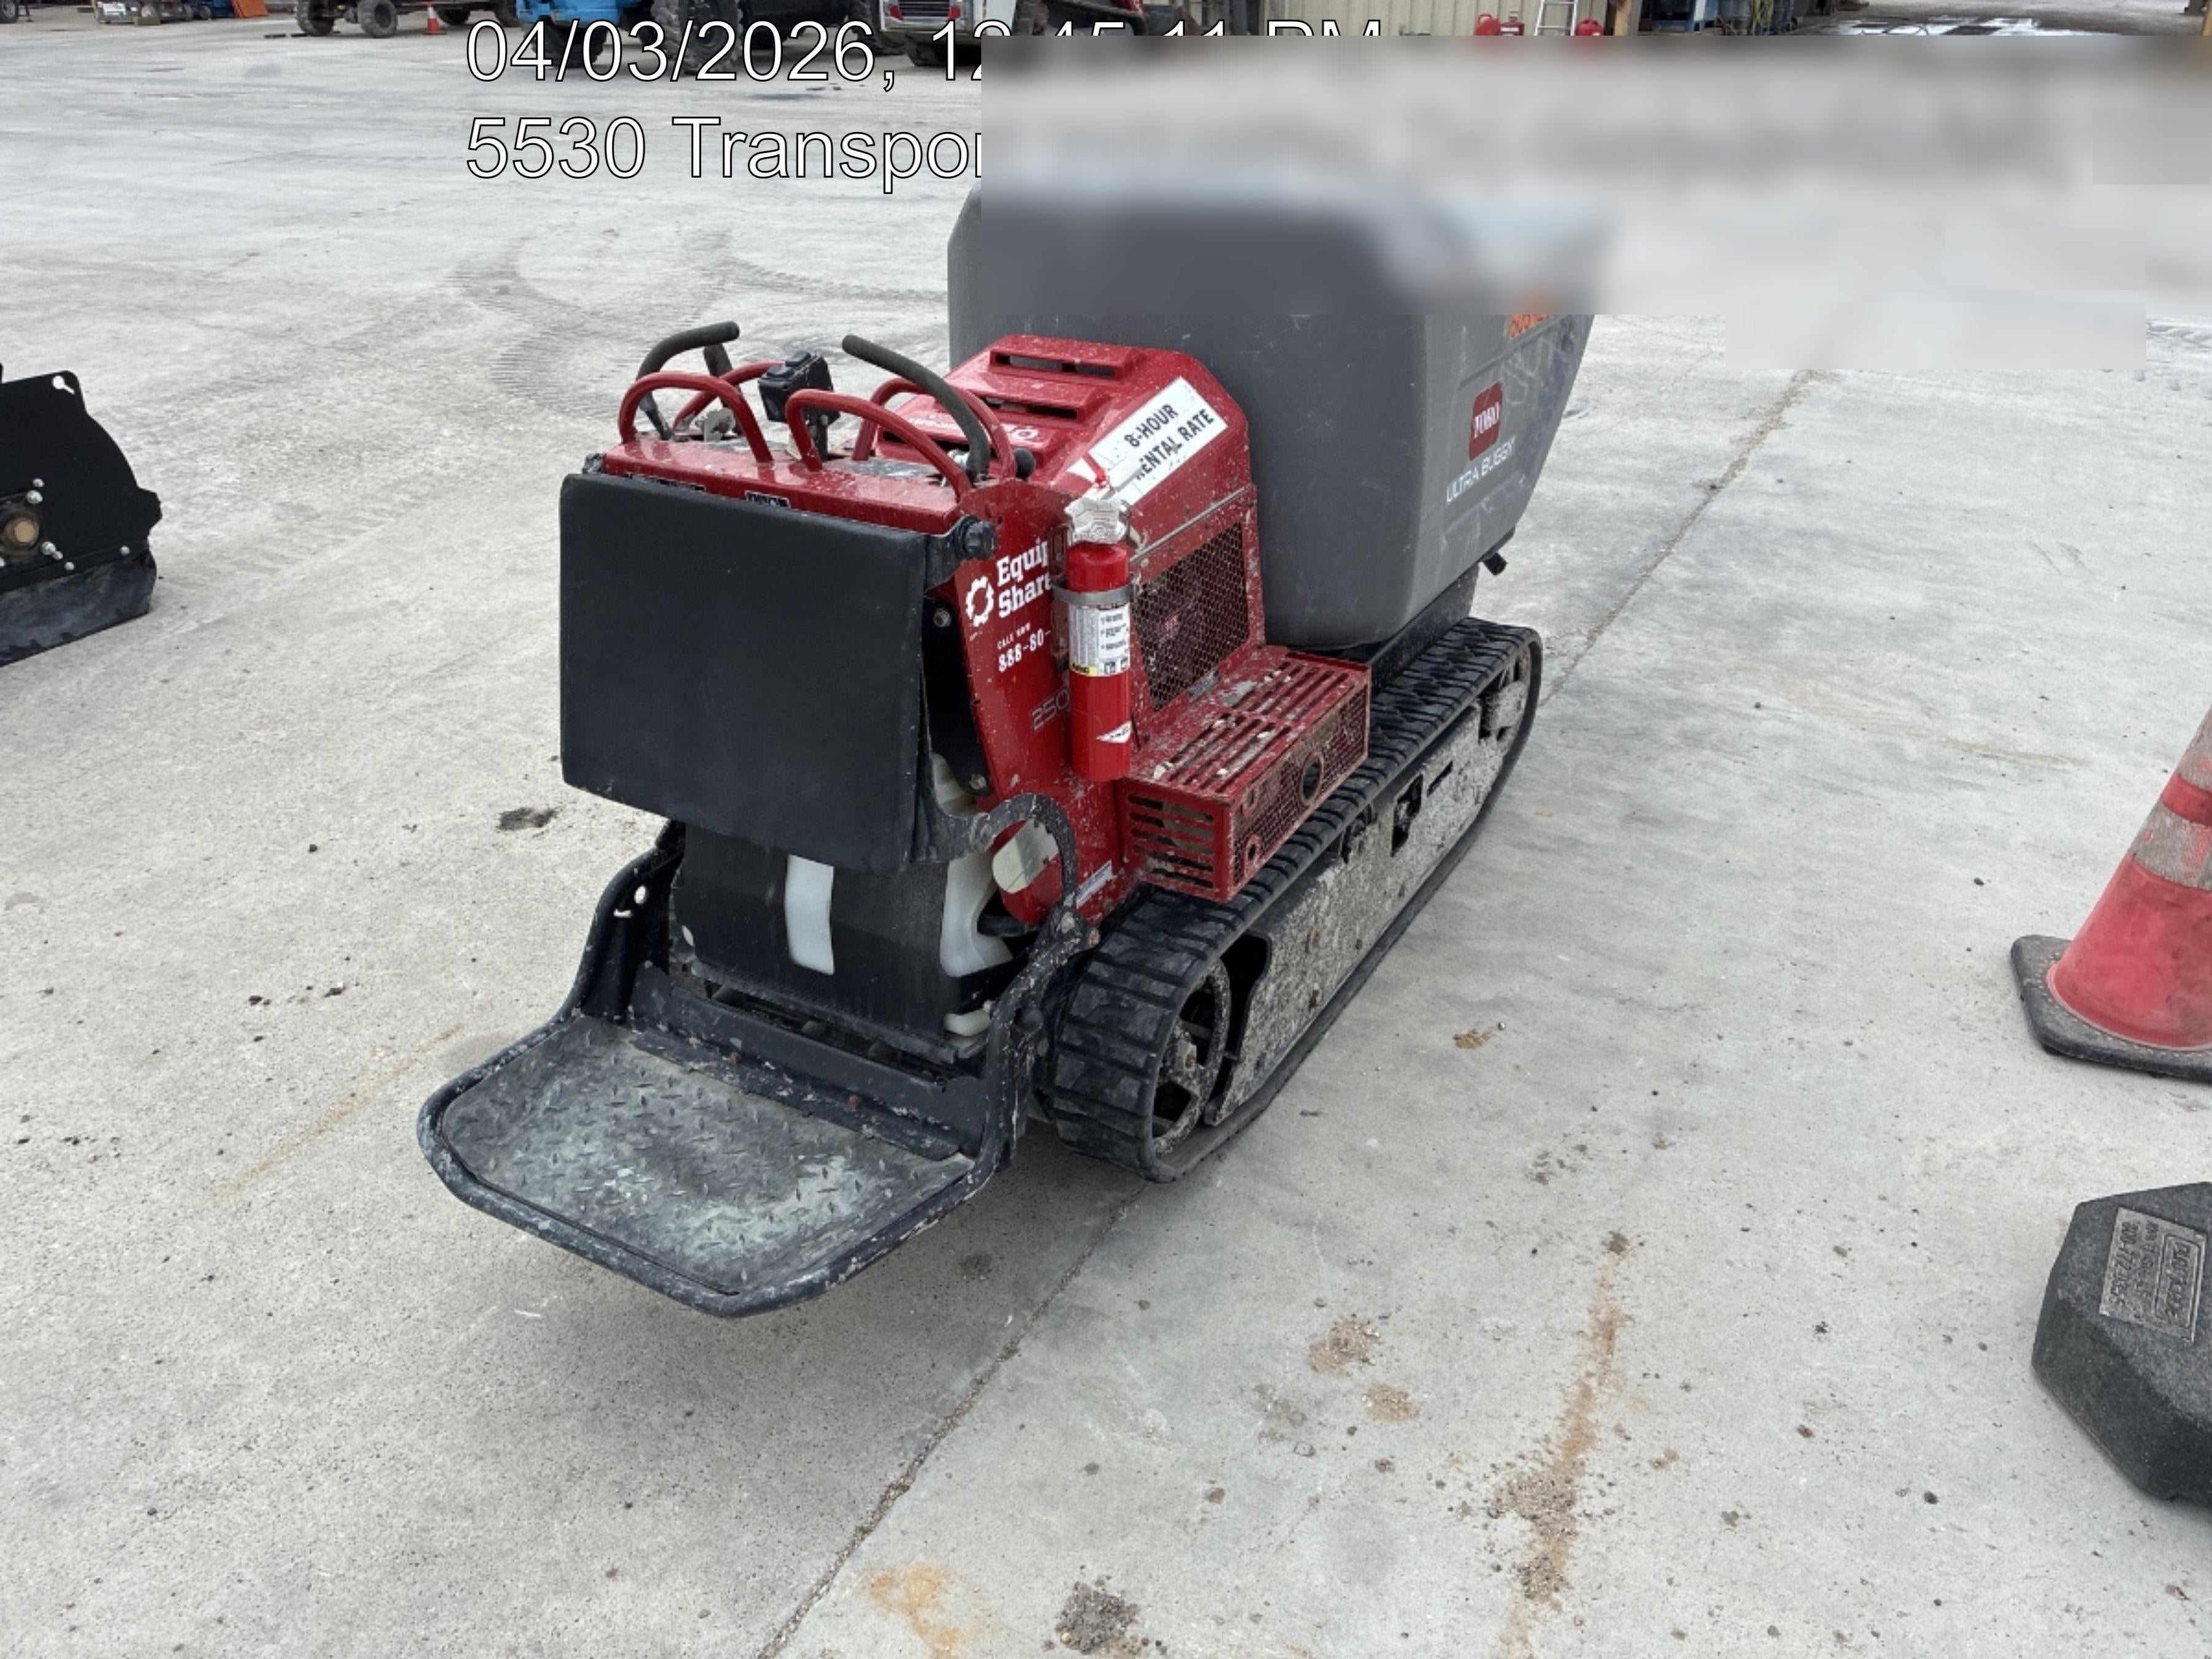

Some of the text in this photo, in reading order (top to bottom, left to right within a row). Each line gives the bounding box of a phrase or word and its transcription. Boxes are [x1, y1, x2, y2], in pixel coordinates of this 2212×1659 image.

[1124, 404, 1179, 447] 8-HOUR
[1136, 409, 1215, 481] ENTAL RATE
[1473, 401, 1500, 439] TORO
[1446, 434, 1516, 503] ULTRA BUGGY
